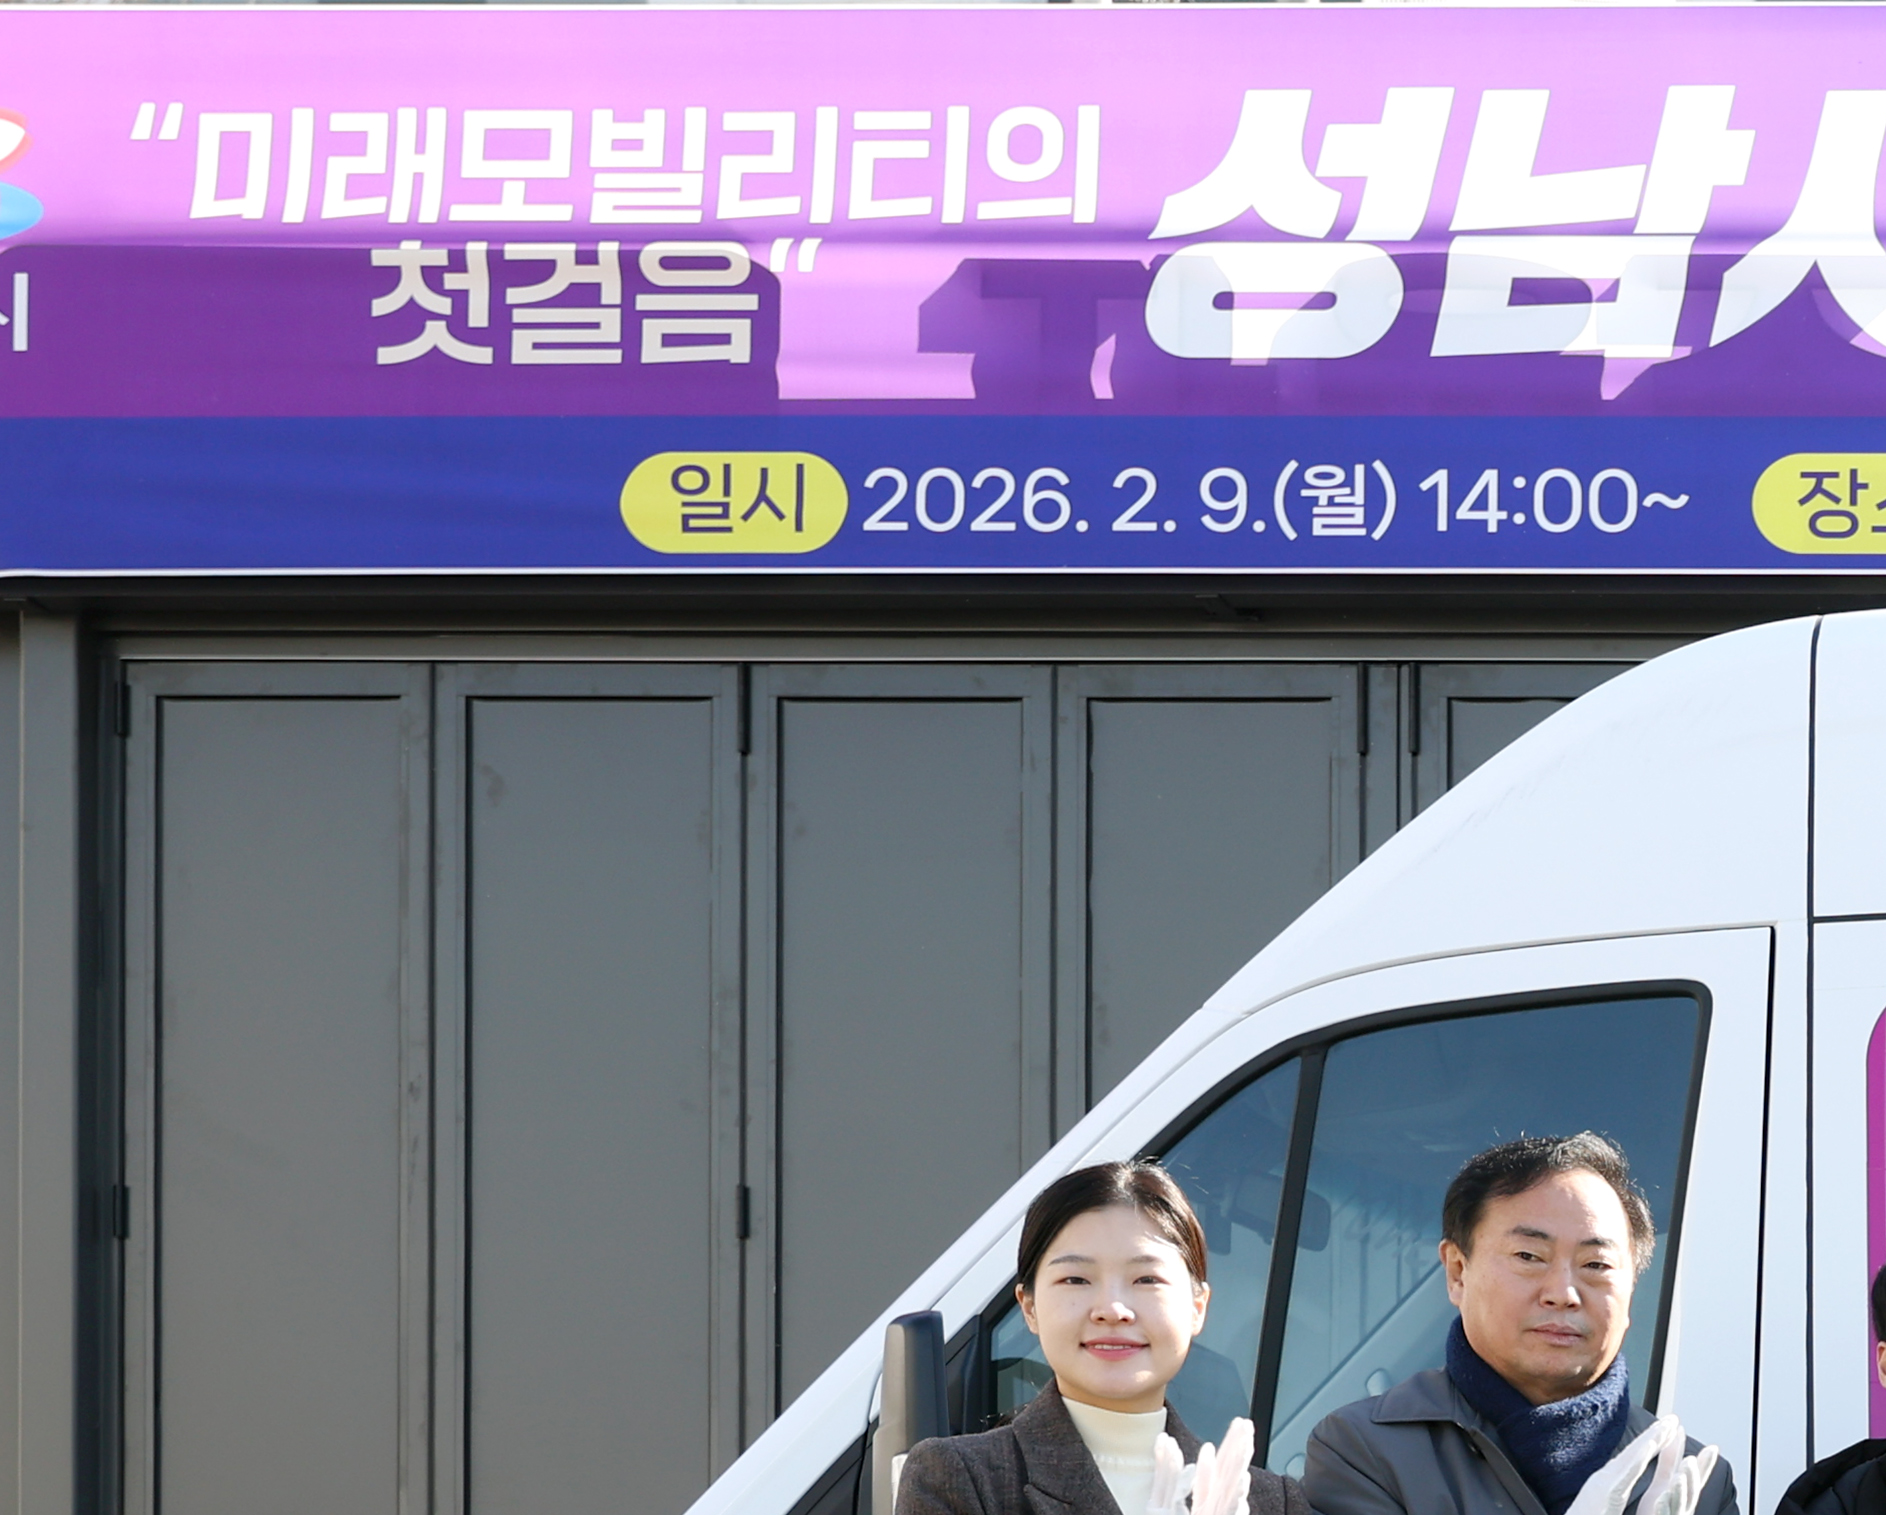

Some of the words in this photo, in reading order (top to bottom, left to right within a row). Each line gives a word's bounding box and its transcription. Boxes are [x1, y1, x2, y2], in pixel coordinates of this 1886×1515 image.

[671, 464, 804, 533] 일시
[863, 468, 1088, 533] 2026.
[1112, 468, 1176, 533] 2.
[1200, 460, 1396, 540] 9.(월)
[1419, 468, 1689, 533] 14:00~
